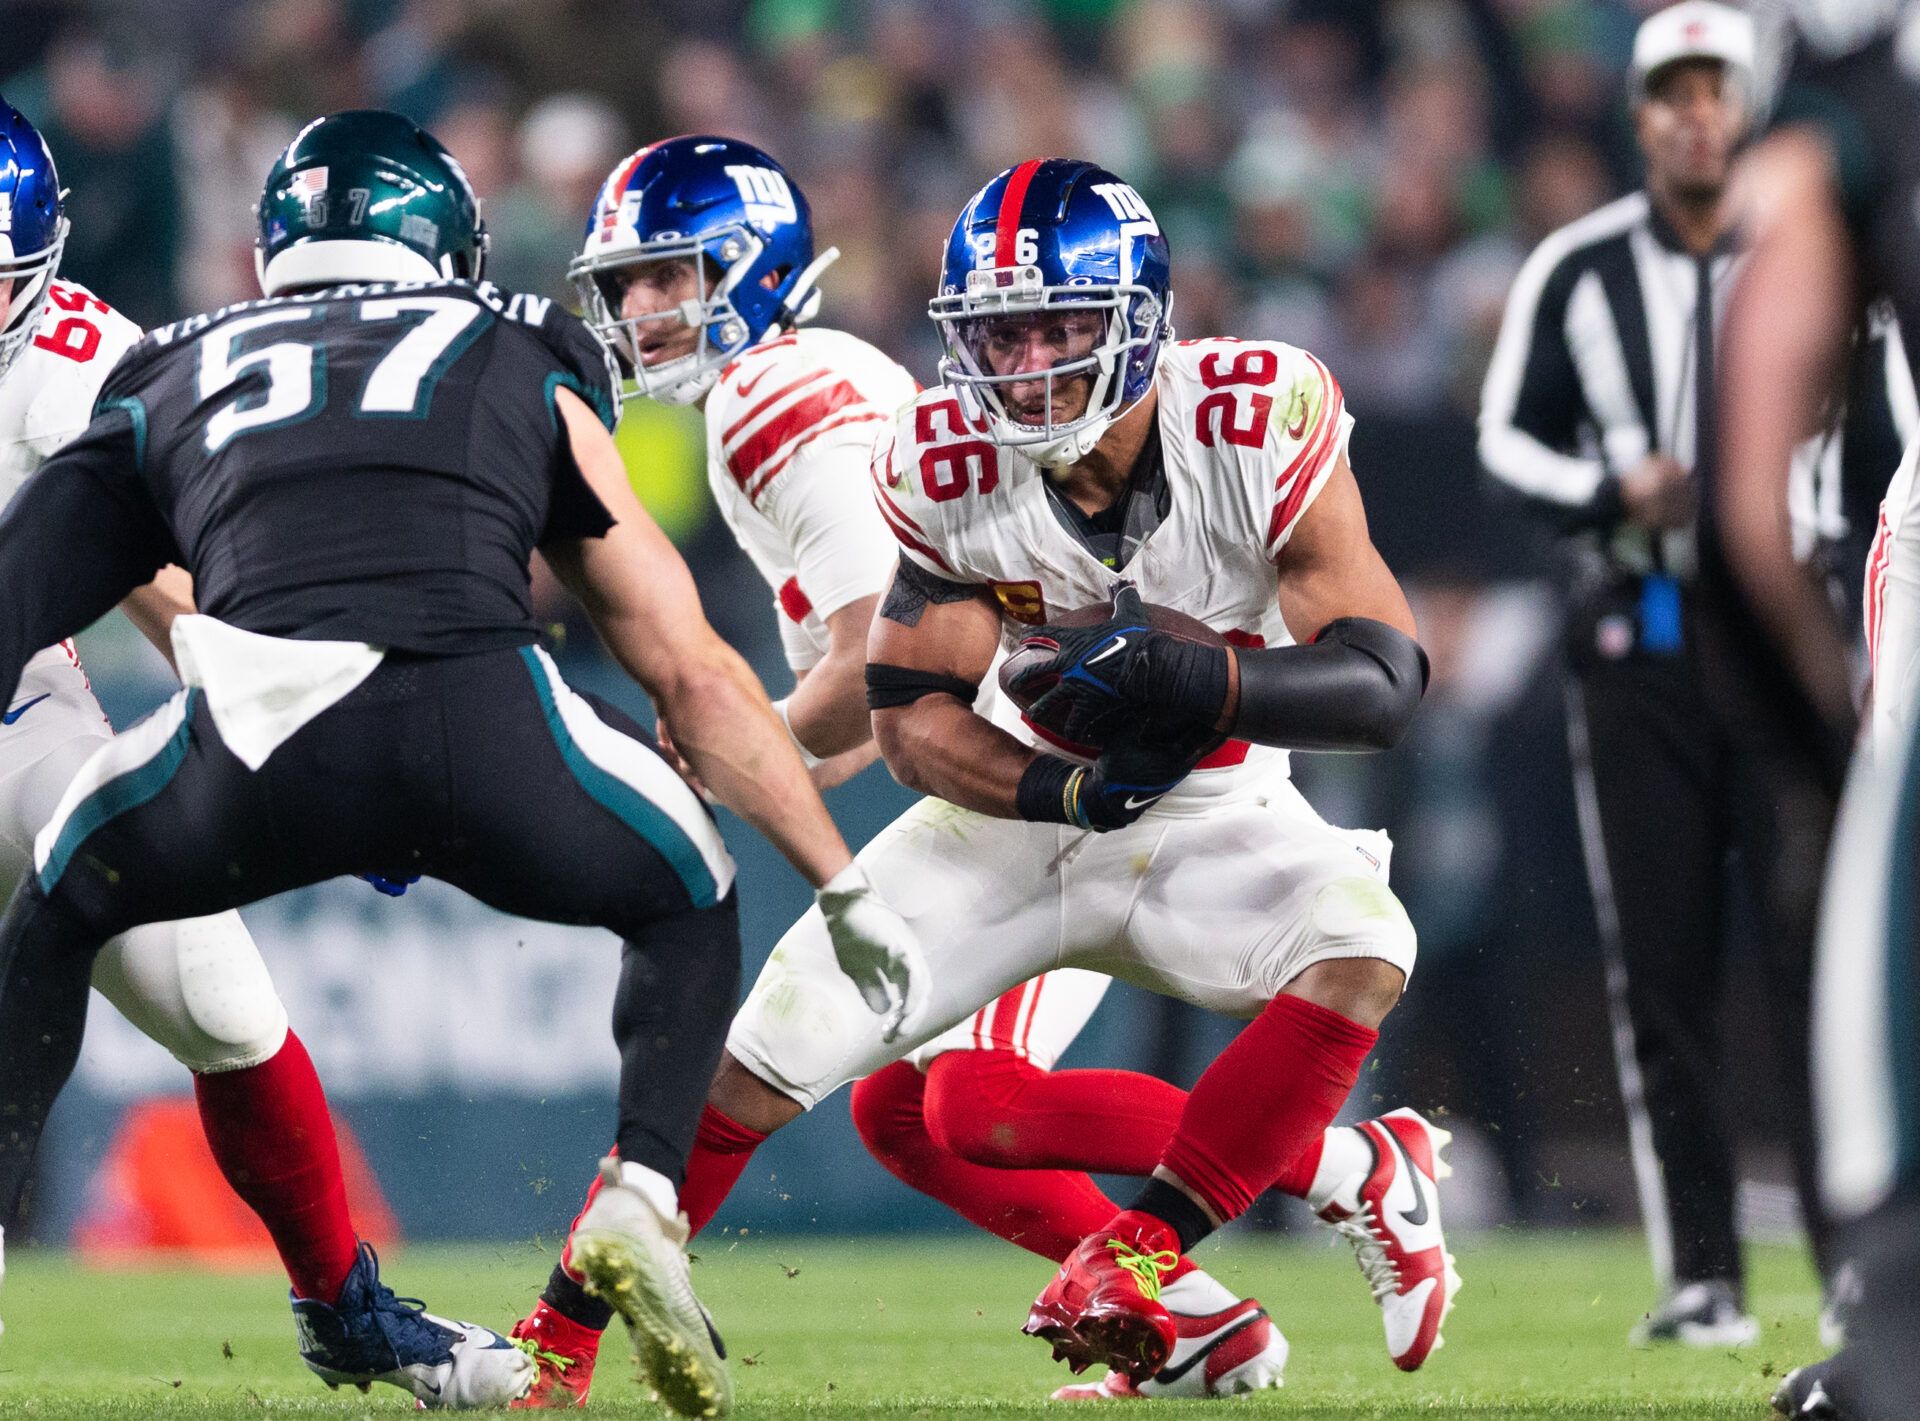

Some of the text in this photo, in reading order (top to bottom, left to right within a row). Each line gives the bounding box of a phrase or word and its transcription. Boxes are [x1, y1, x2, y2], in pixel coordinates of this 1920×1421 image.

[976, 228, 1039, 269] 26
[199, 302, 488, 452] 57
[1196, 349, 1277, 449] 26
[915, 398, 1000, 503] 26
[994, 584, 1041, 614] C
